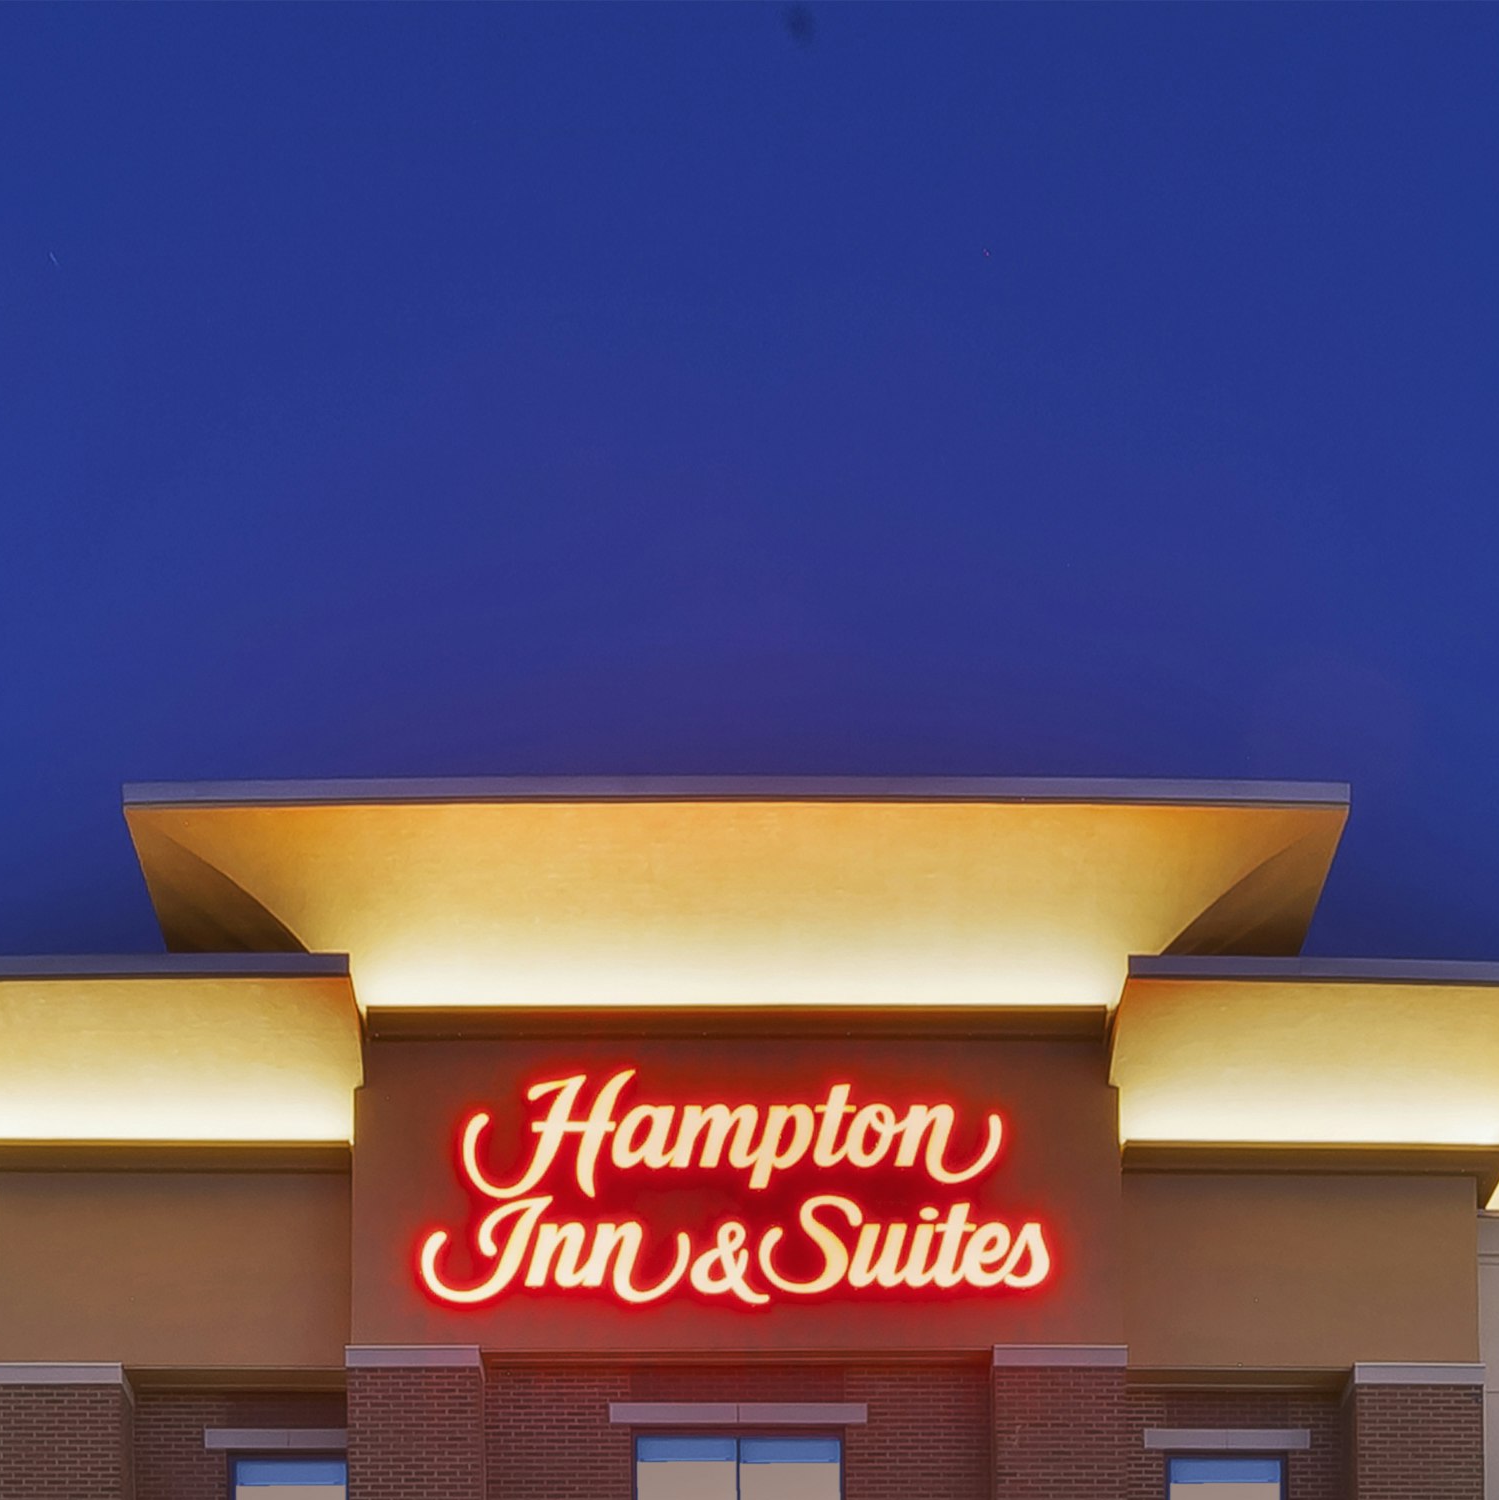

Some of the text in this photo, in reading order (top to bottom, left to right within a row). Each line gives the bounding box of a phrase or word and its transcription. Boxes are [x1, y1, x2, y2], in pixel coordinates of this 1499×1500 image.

[463, 1069, 1002, 1198] Hampton
[420, 1195, 1050, 1304] Inn & Suites
